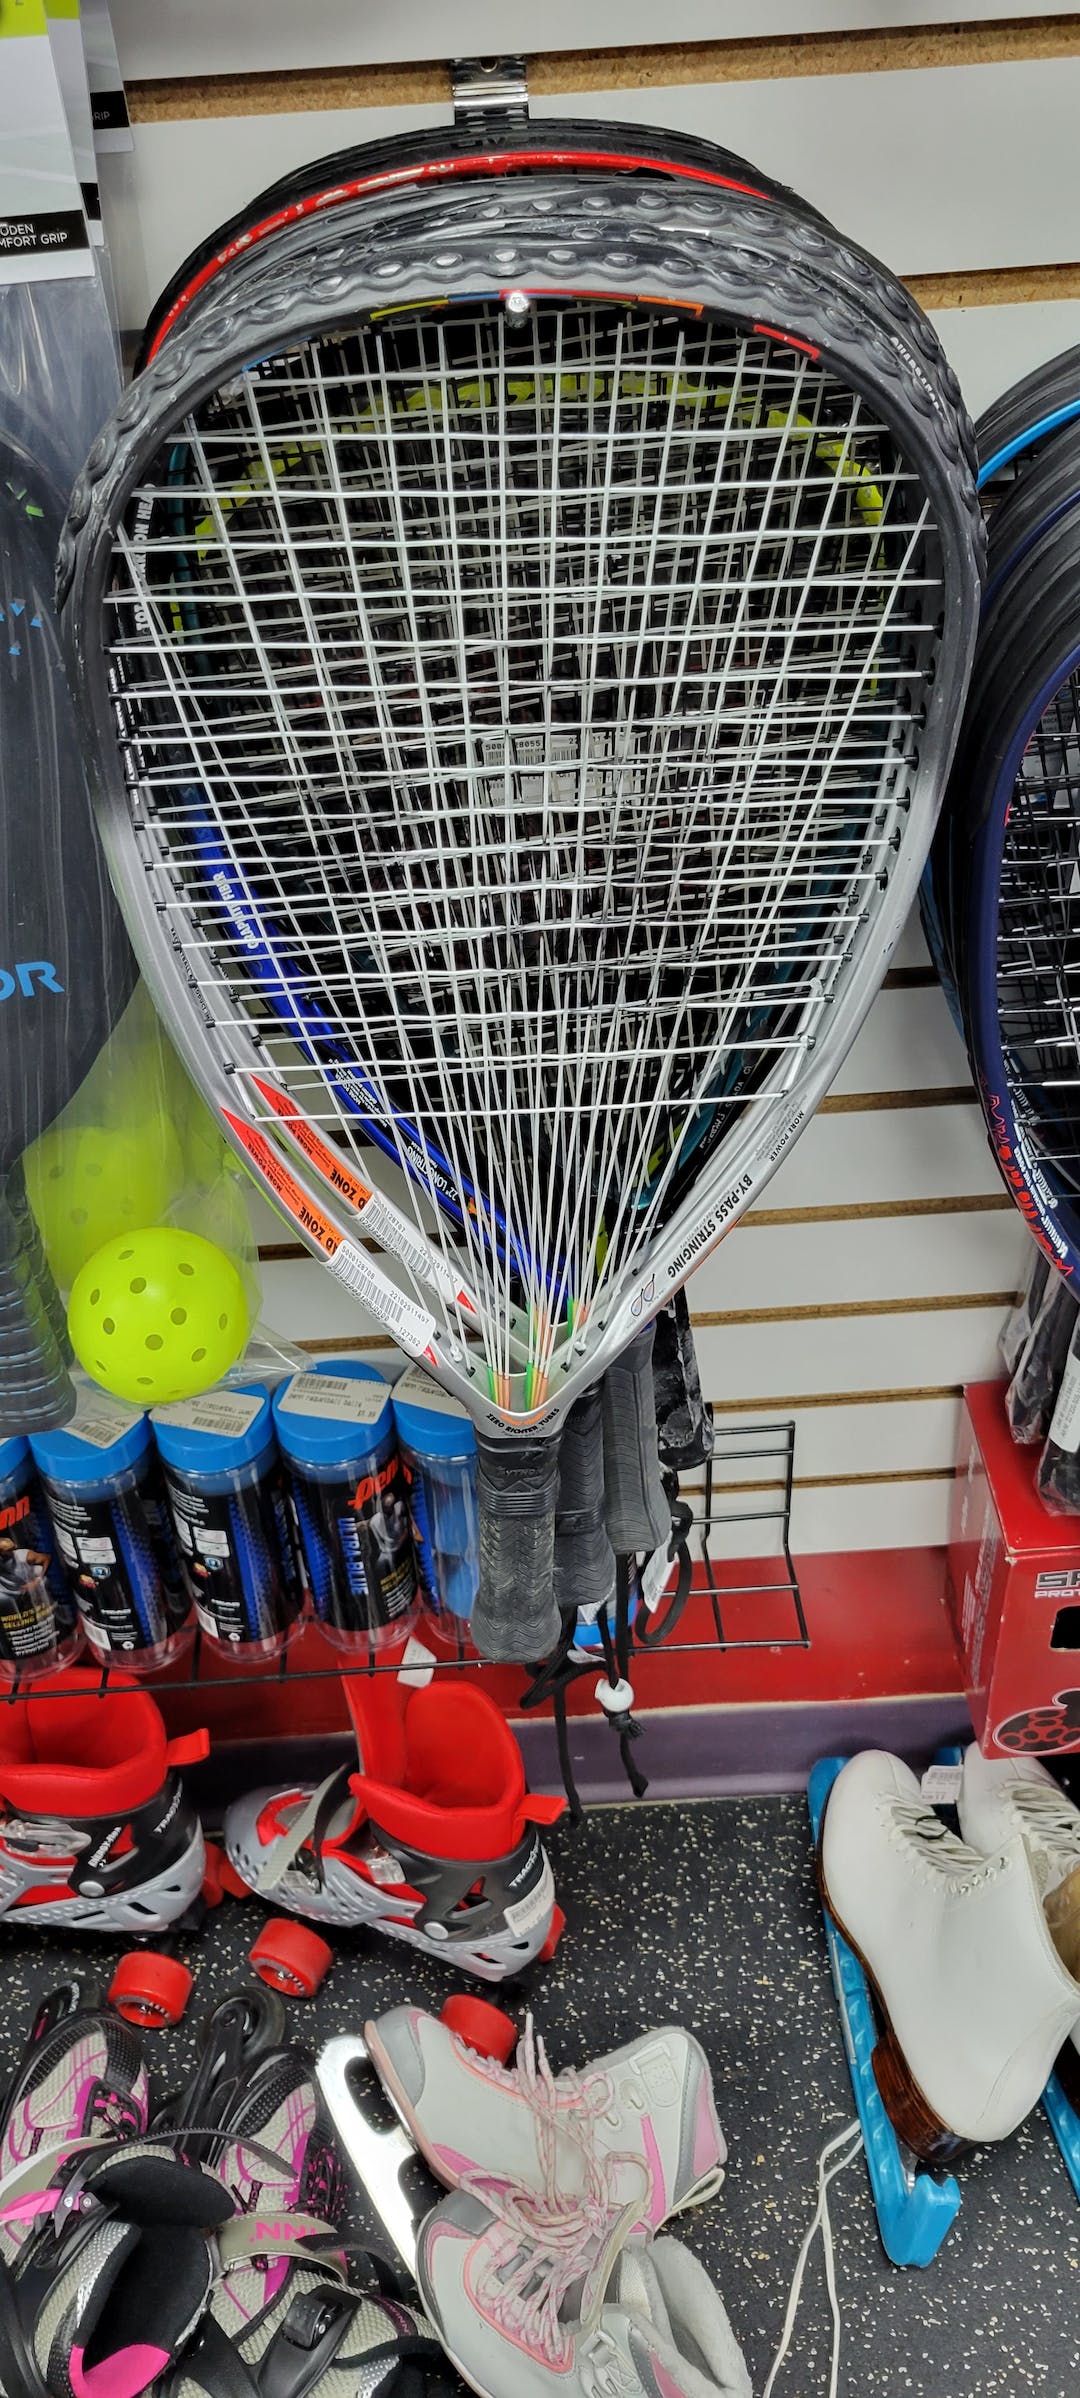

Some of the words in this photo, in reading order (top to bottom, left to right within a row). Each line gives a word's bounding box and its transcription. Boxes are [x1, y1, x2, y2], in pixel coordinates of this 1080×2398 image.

[91, 110, 111, 121] RIP
[40, 232, 68, 245] GRIP
[786, 1109, 805, 1133] MORE
[246, 1143, 267, 1171] POWER
[769, 1131, 790, 1163] POWER
[265, 1167, 284, 1193] MORE
[329, 1168, 358, 1201] ZONE
[714, 1172, 754, 1224] BY-PASS
[299, 1206, 326, 1240] ZONE
[666, 1220, 717, 1280] STRINGING
[486, 1412, 505, 1428] ZERO
[505, 1424, 538, 1435] RICHTER
[538, 1407, 560, 1427] TUBES
[338, 1516, 369, 1596] ULTRA-BLUE
